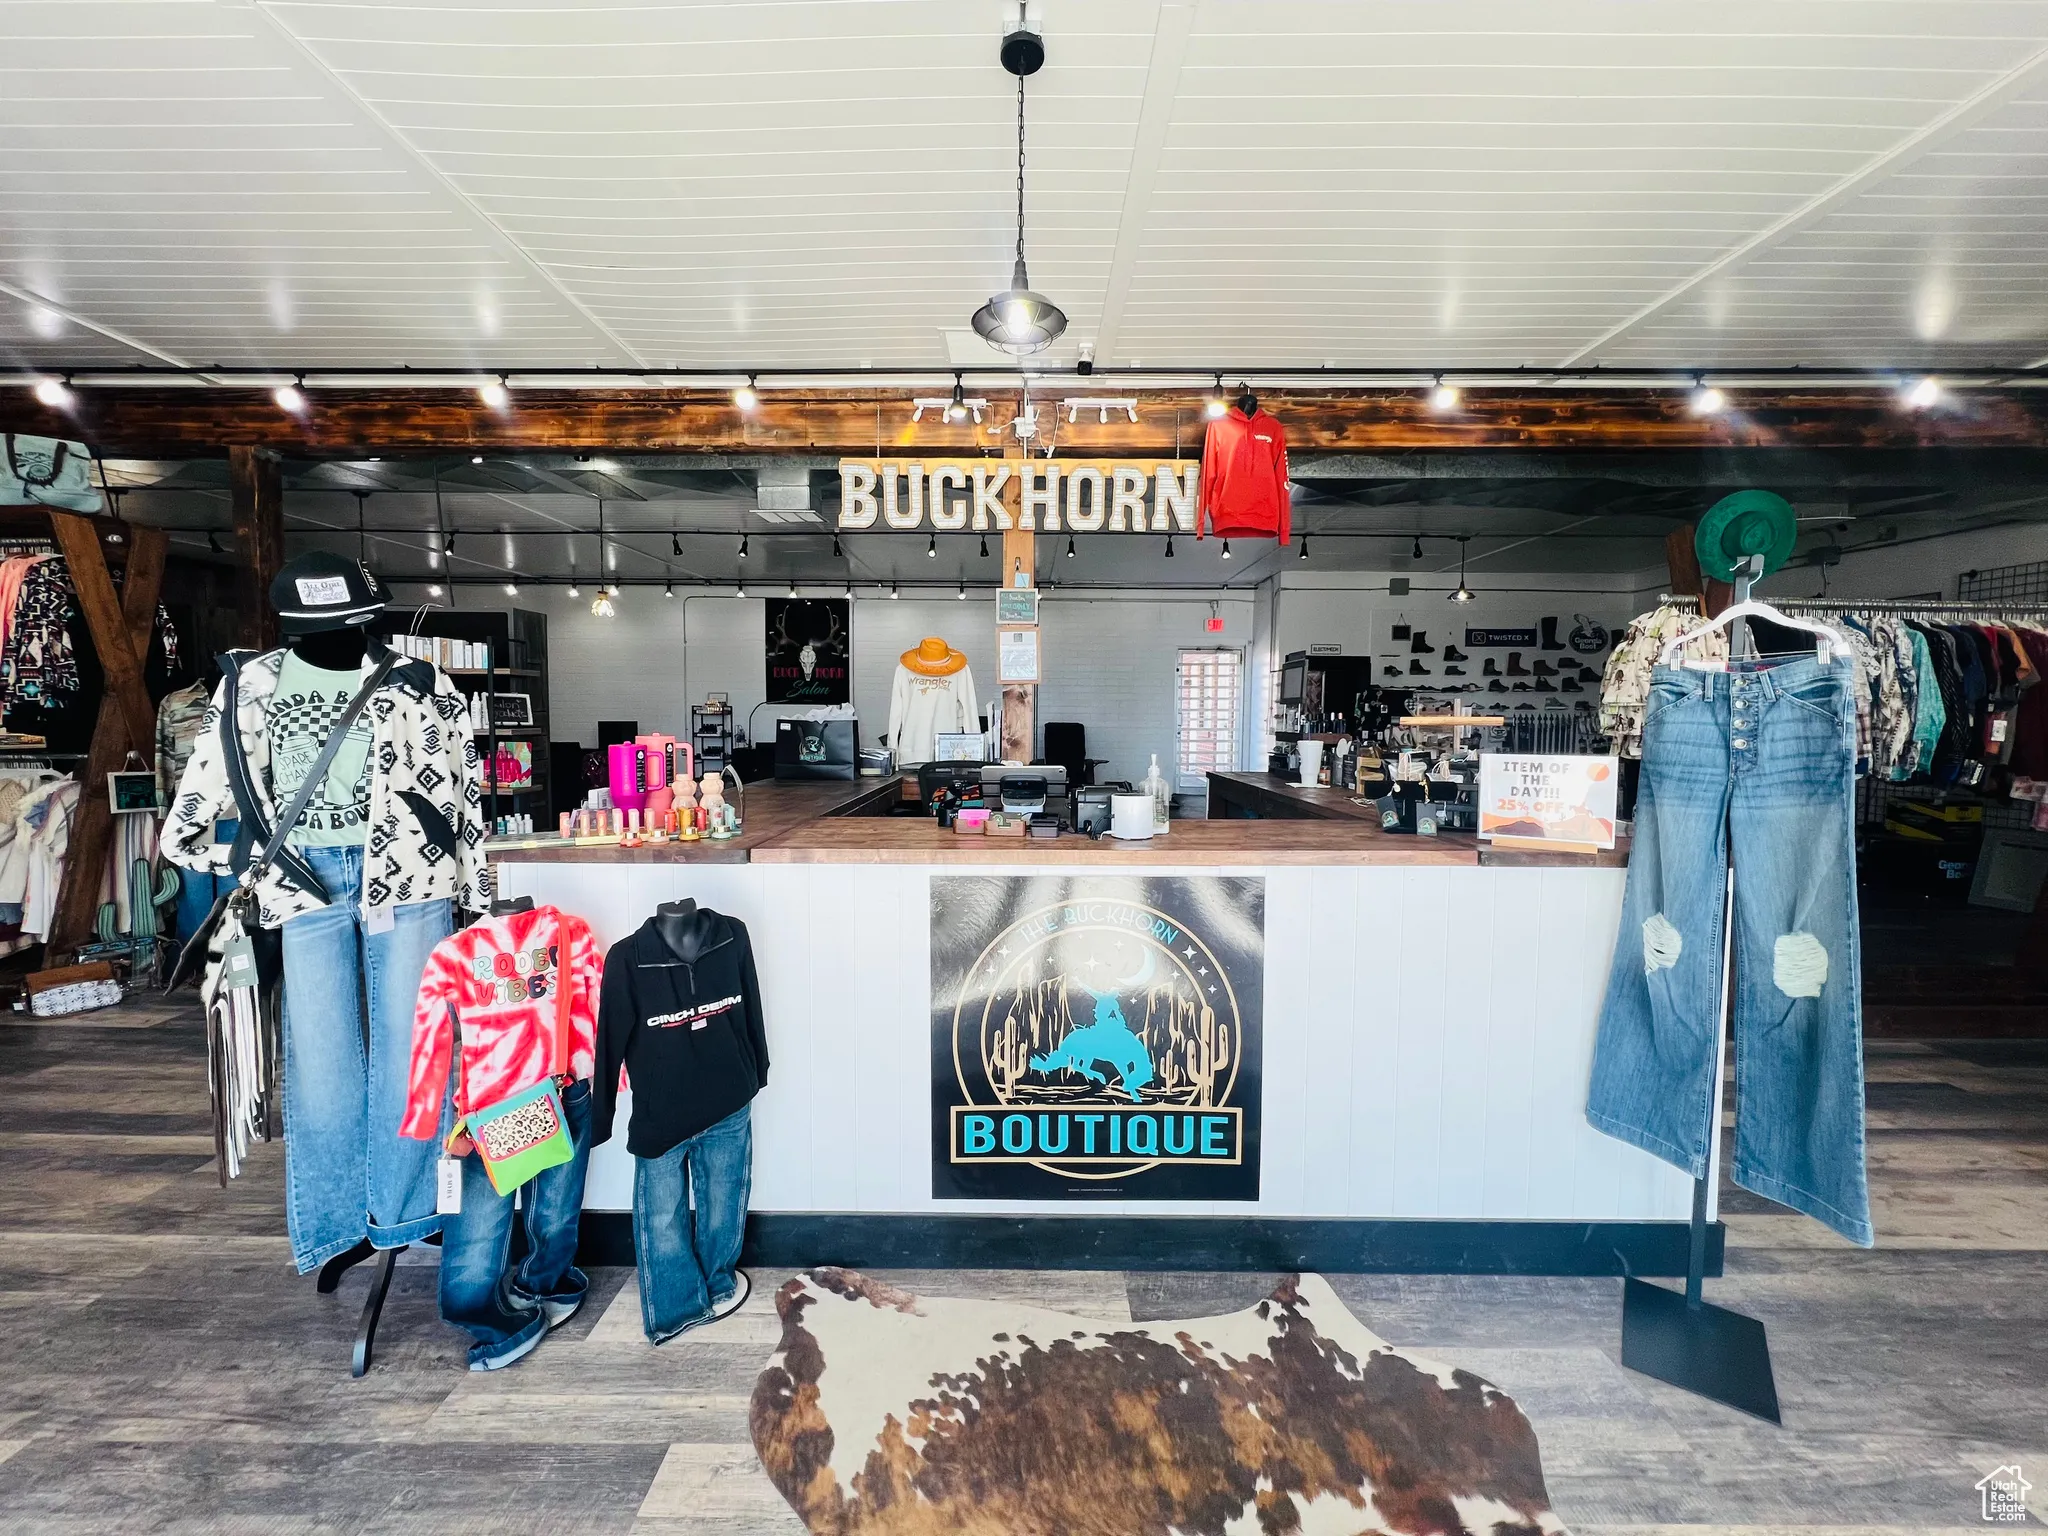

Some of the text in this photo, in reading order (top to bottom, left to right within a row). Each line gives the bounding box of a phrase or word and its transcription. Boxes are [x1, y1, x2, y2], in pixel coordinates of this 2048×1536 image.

[838, 463, 1200, 531] BUCKHORN
[1574, 636, 1602, 645] Georgia
[785, 680, 831, 698] Salon
[907, 676, 952, 690] Wrangler
[279, 751, 314, 771] SPARE
[1503, 761, 1570, 774] ITEM OF
[1521, 774, 1550, 785] THE
[1511, 786, 1560, 799] DAY!!!
[1497, 798, 1564, 814] 25% OFF
[1018, 904, 1179, 945] THE BUCKHORN
[646, 994, 742, 1027] CINCH DENIM
[963, 1114, 1229, 1156] BOUTIQUE
